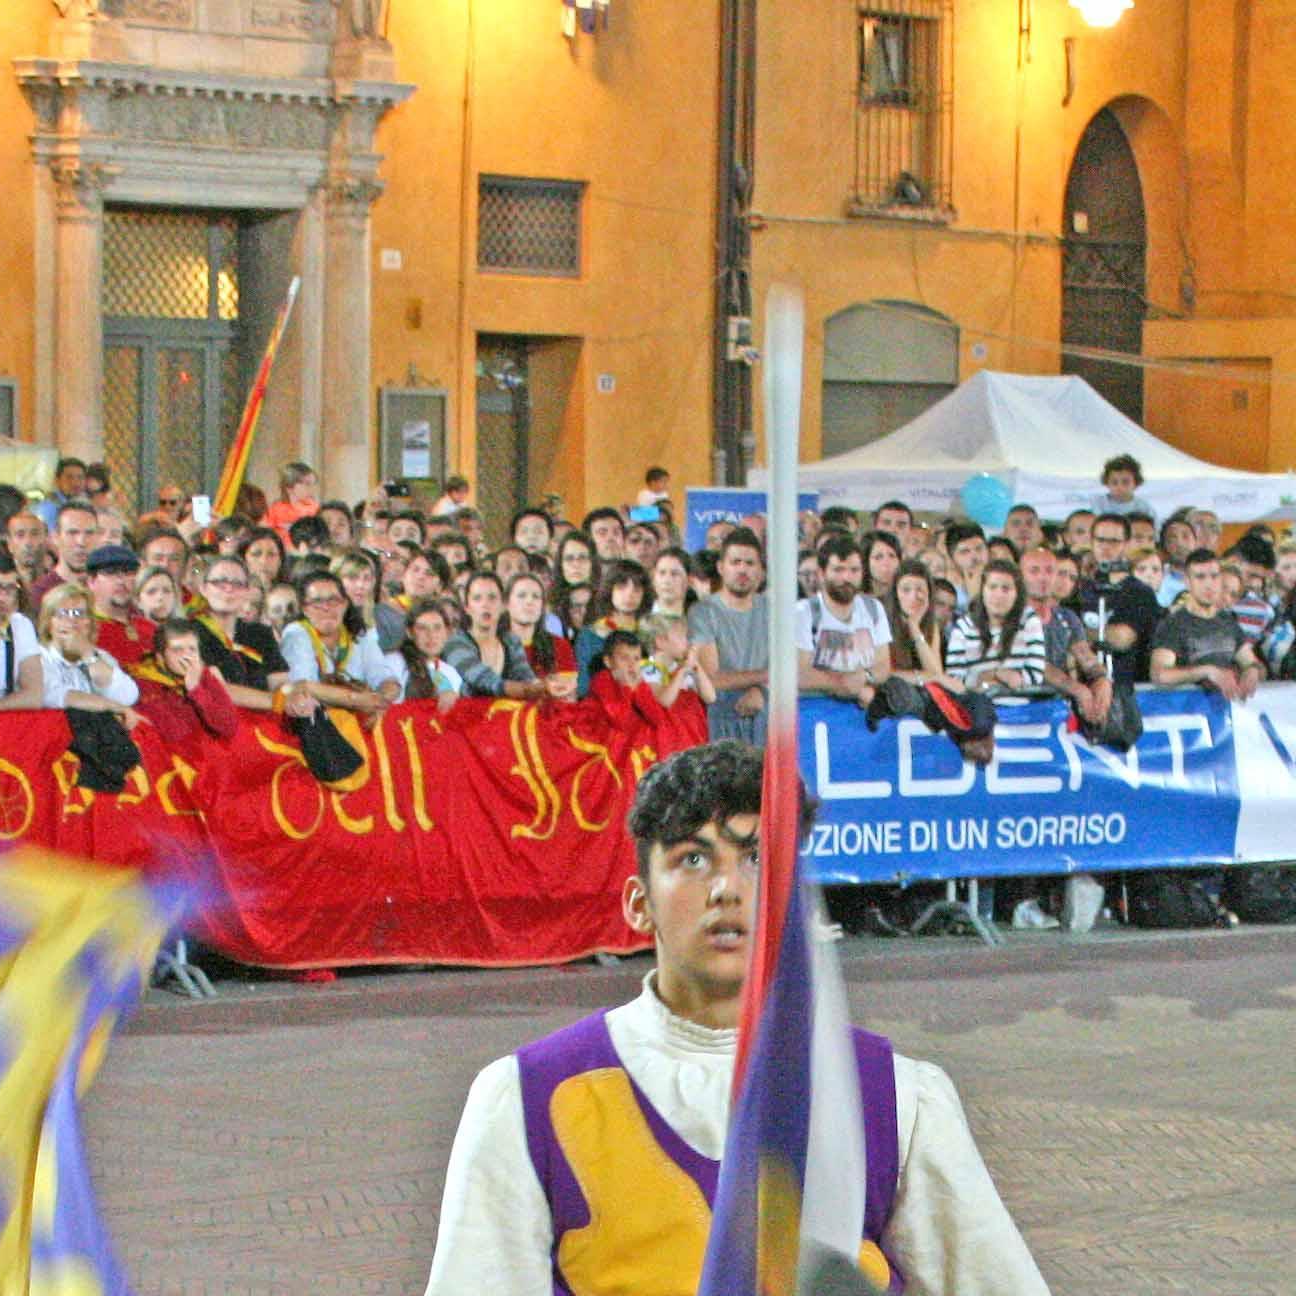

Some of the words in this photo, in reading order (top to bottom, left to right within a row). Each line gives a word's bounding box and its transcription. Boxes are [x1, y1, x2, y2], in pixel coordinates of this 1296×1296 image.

[814, 712, 1214, 800] LDENT
[910, 820, 938, 854] DI
[947, 819, 990, 851] UN
[996, 812, 1126, 847] SORRISO
